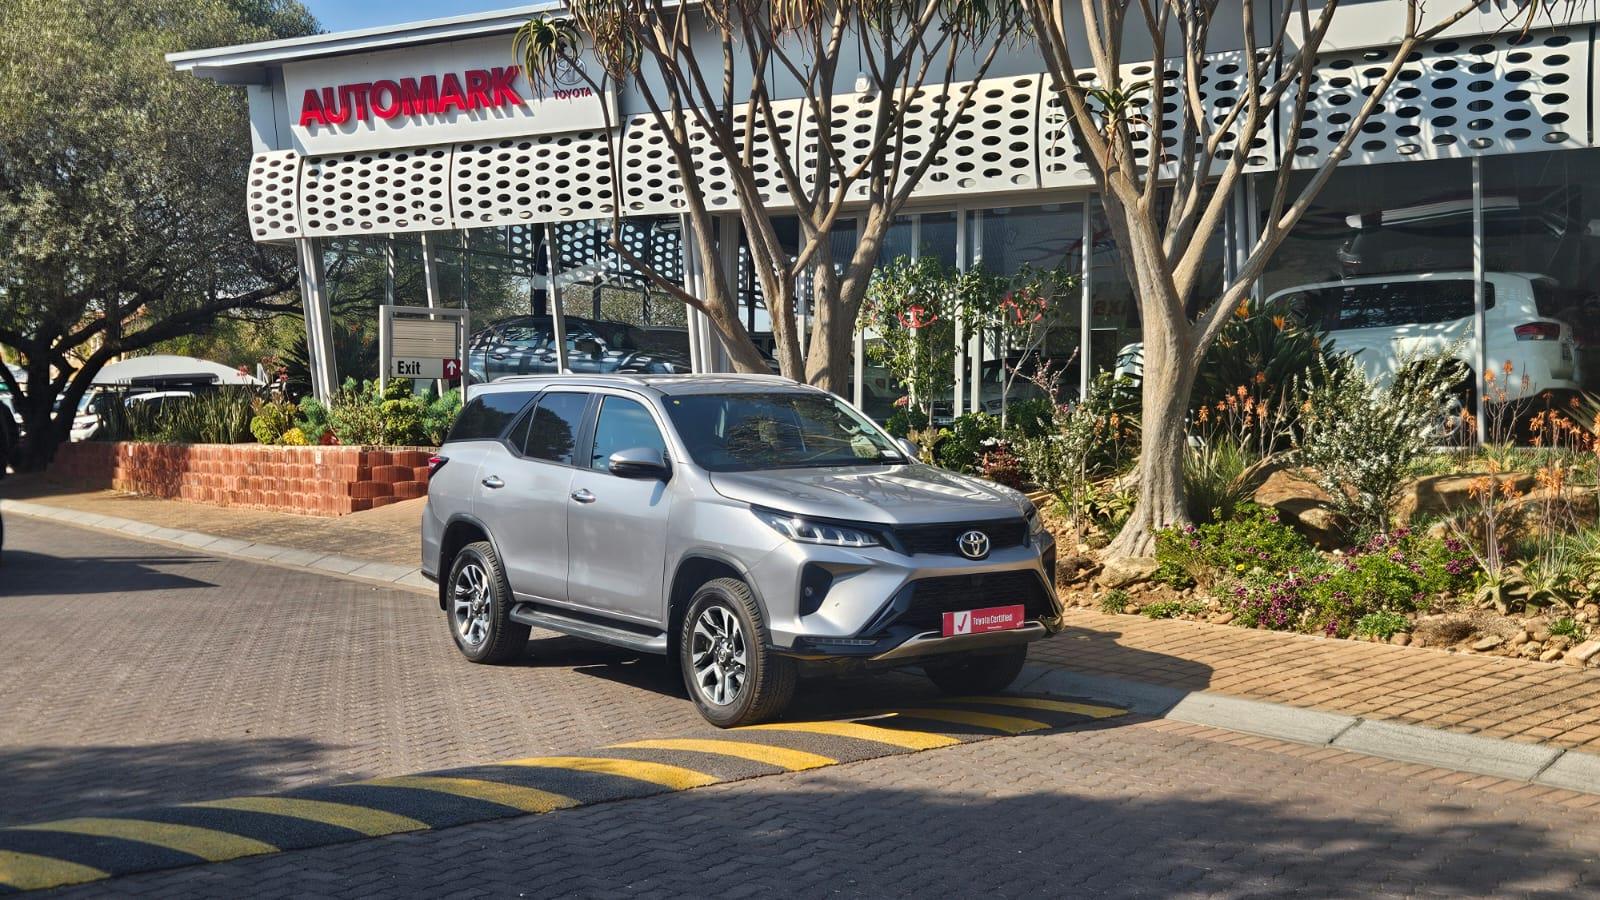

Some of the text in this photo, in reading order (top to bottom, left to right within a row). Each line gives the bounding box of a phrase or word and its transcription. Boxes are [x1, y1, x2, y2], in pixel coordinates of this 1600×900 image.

[300, 65, 524, 126] AUTOMARK
[553, 87, 592, 100] TOYOTA
[397, 361, 421, 375] Exit
[973, 617, 990, 625] Toyota
[991, 614, 1013, 624] Certified
